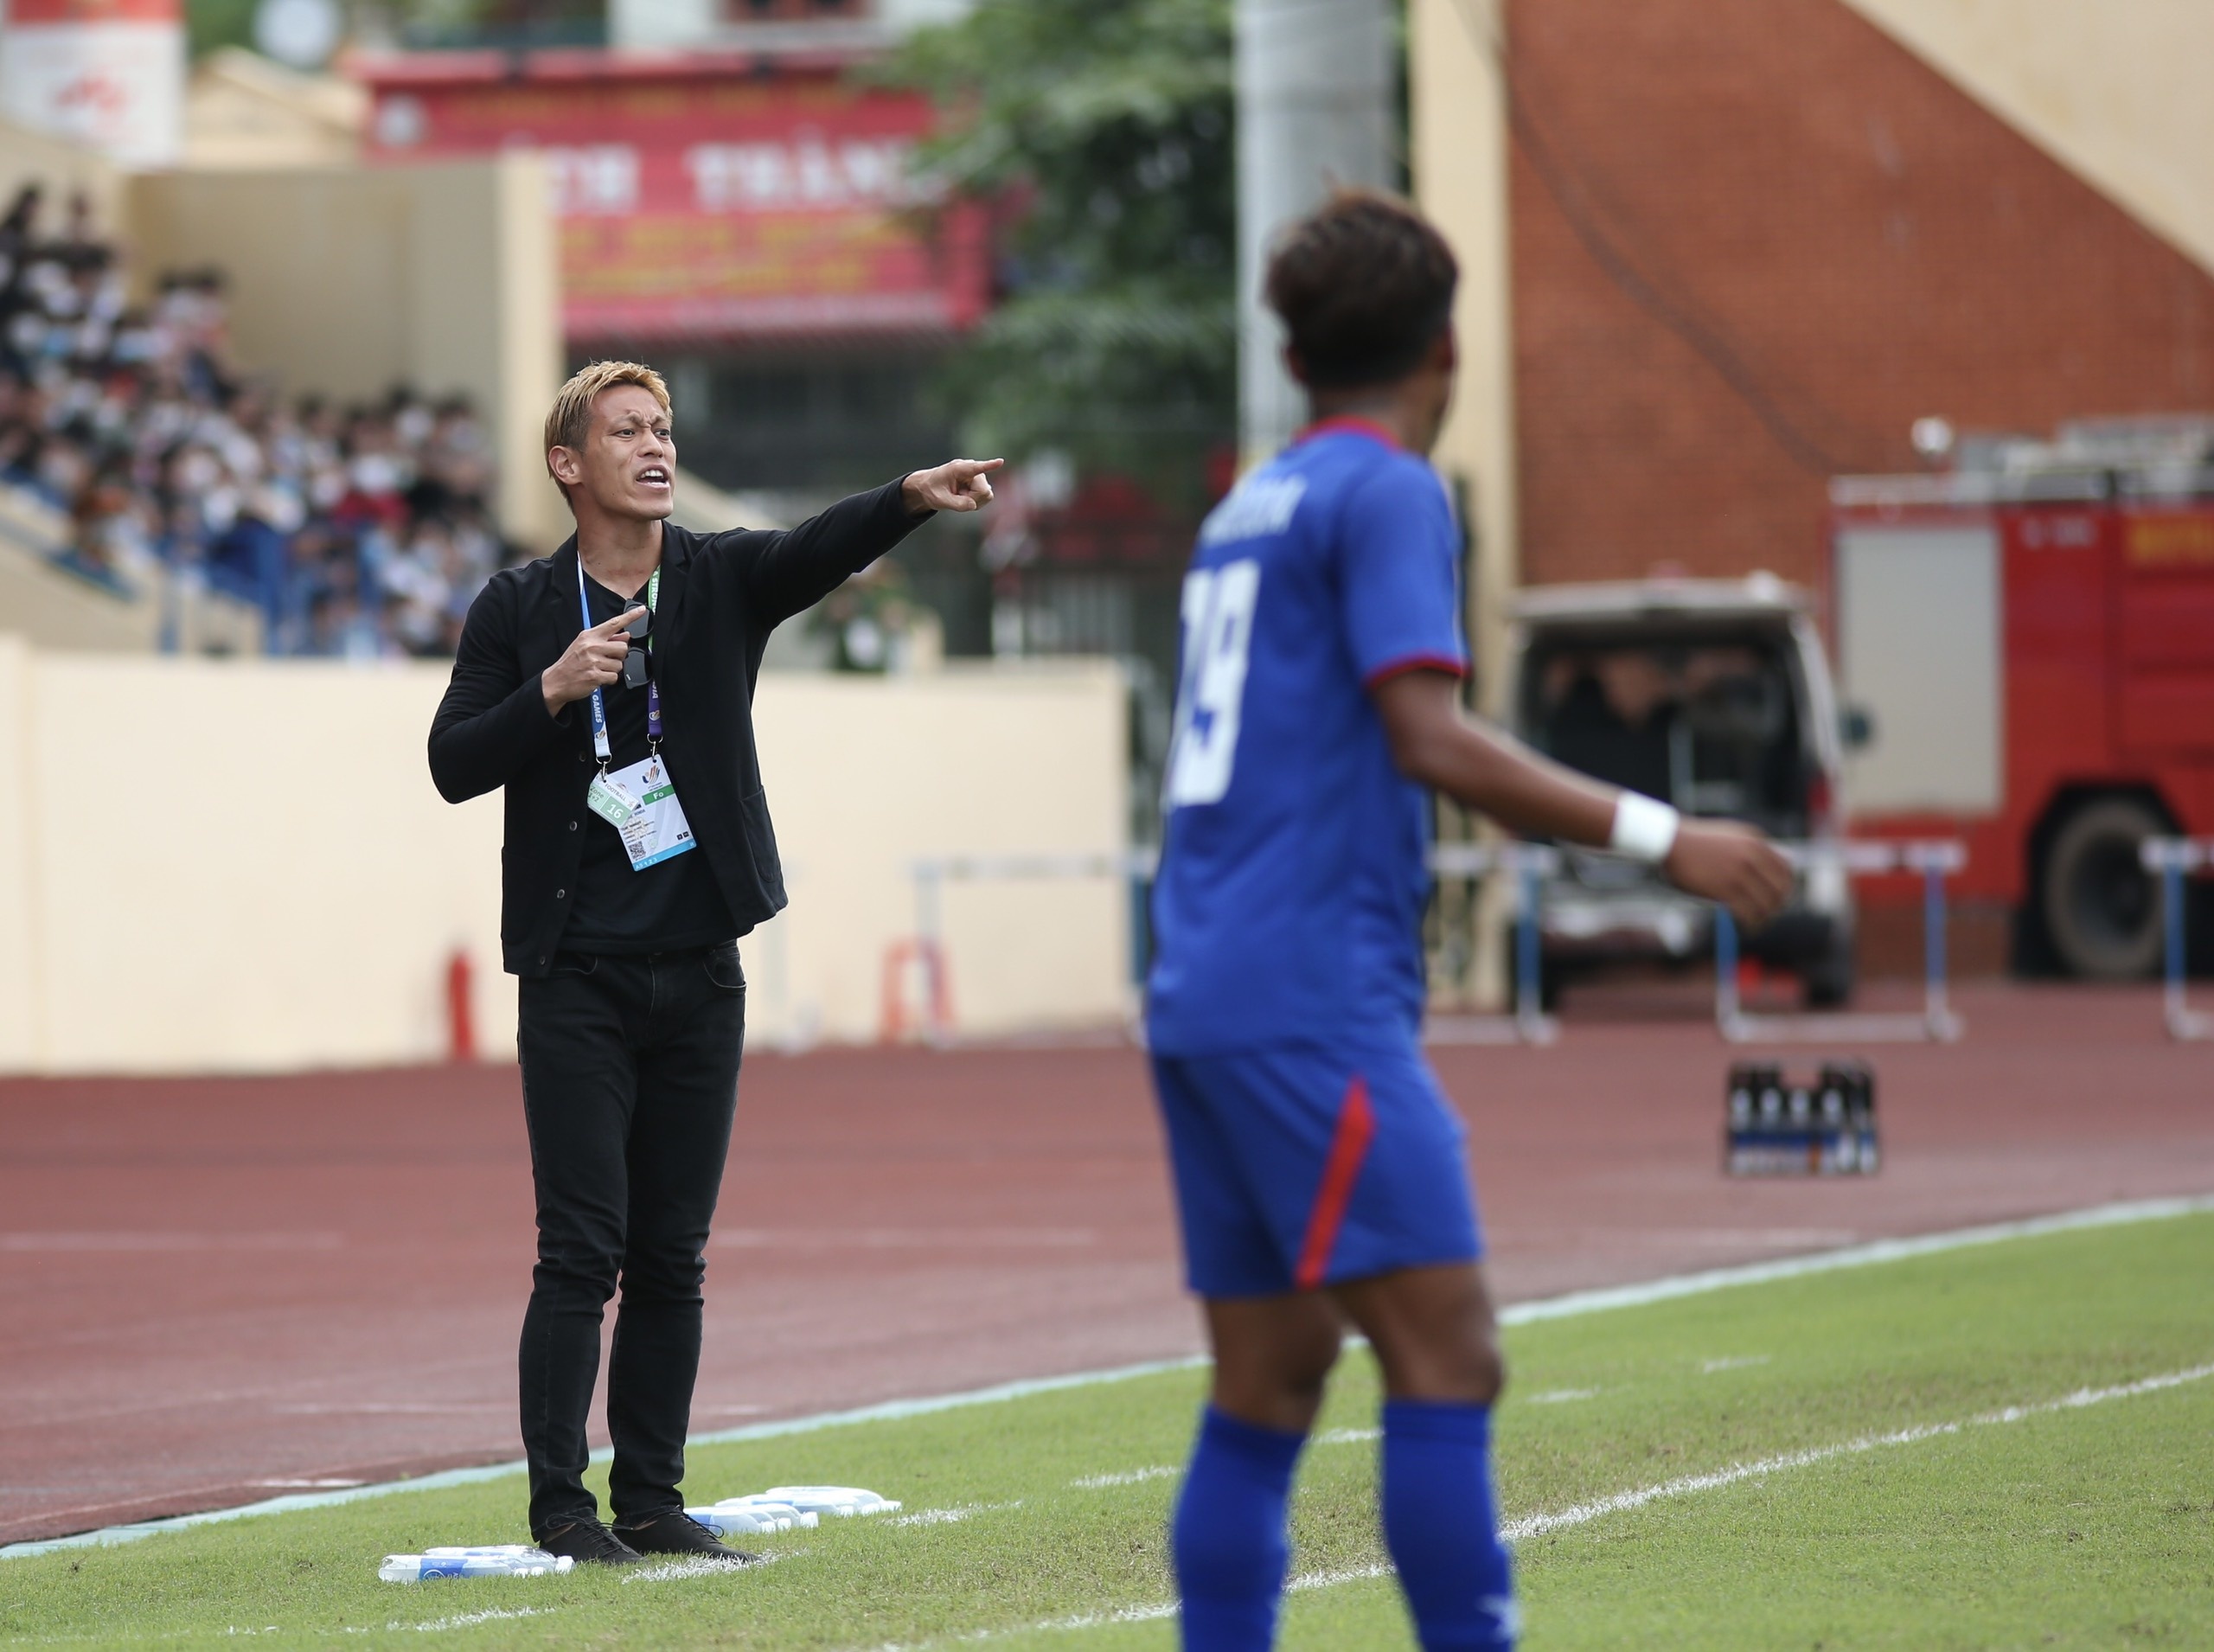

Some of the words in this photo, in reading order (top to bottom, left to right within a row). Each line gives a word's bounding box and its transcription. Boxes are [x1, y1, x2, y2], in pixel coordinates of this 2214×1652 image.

[1162, 557, 1261, 808] 19
[592, 694, 603, 723] GAMES
[590, 786, 605, 799] Zone
[605, 783, 626, 802] FOOTBALL
[653, 791, 664, 800] Fo
[606, 804, 624, 819] 16
